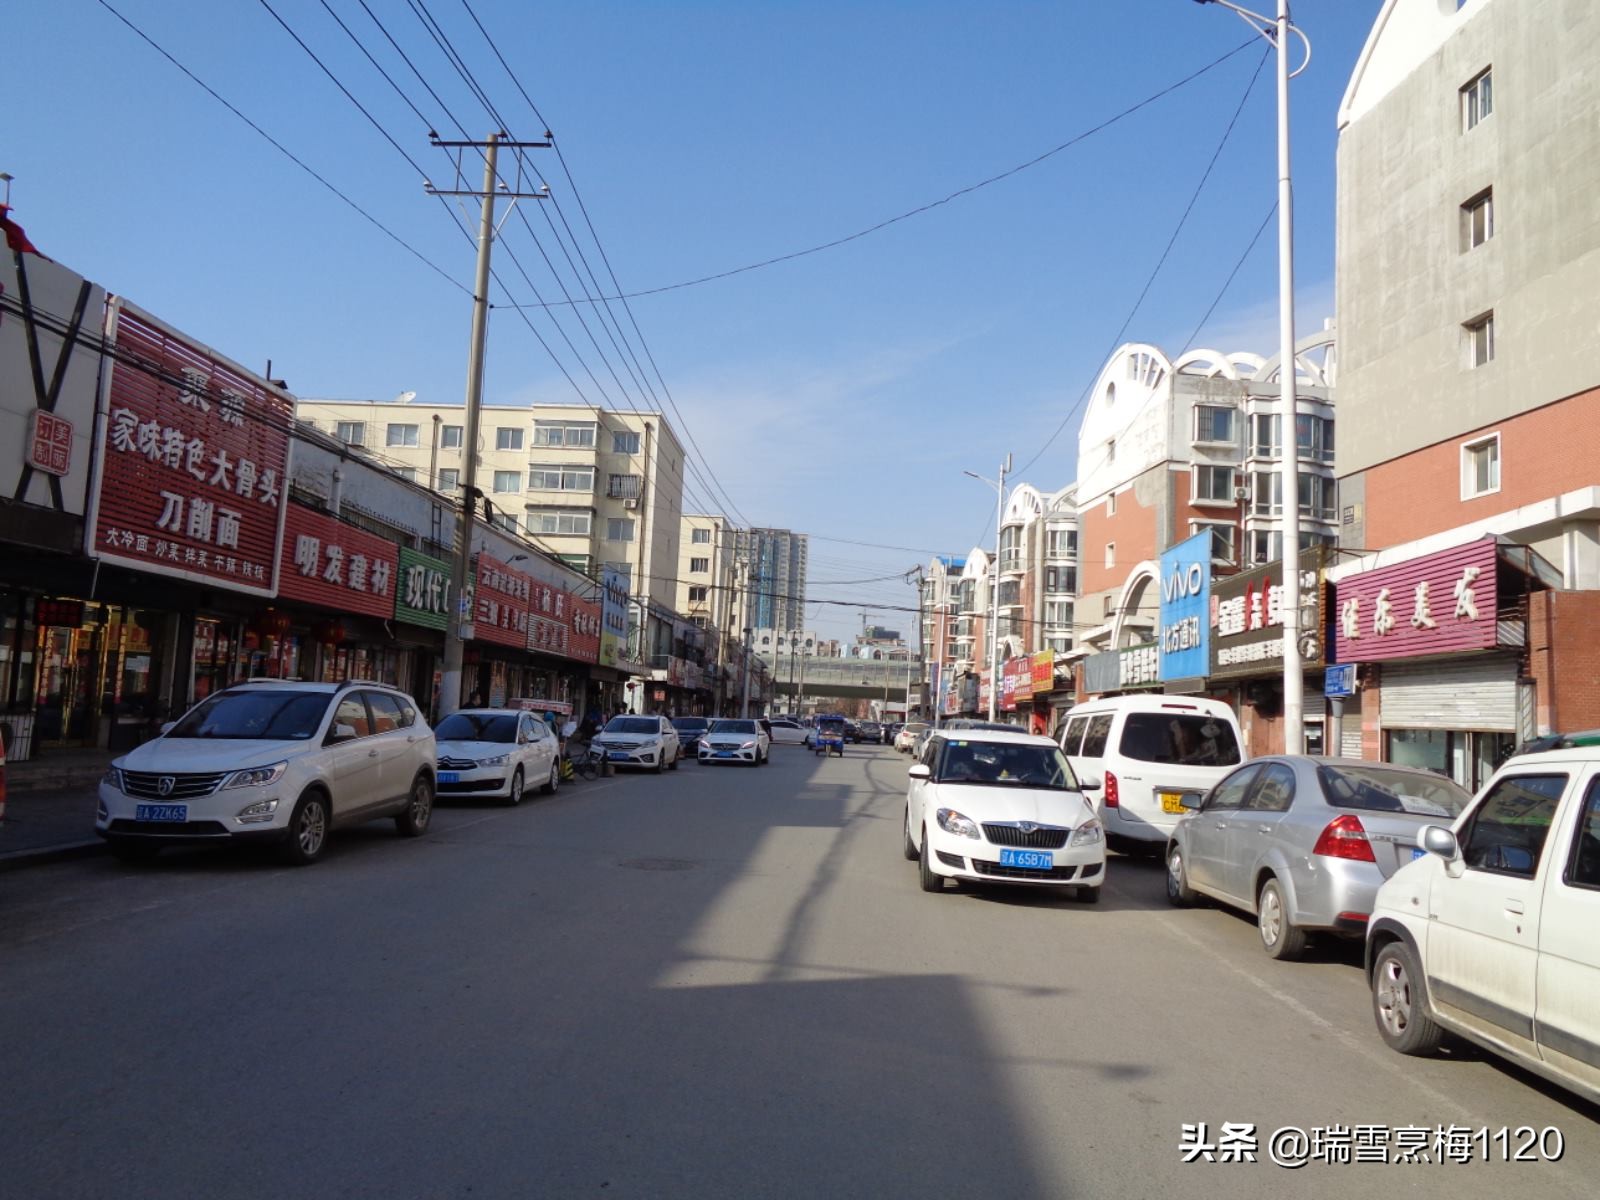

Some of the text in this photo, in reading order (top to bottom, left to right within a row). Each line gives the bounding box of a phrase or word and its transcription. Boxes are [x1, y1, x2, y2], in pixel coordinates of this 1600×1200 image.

[111, 408, 279, 507] 家味特色大骨头
[106, 527, 150, 553] 大冷面
[155, 490, 242, 549] 刀削面
[295, 534, 391, 597] 明发建材
[1162, 560, 1203, 604] vivo
